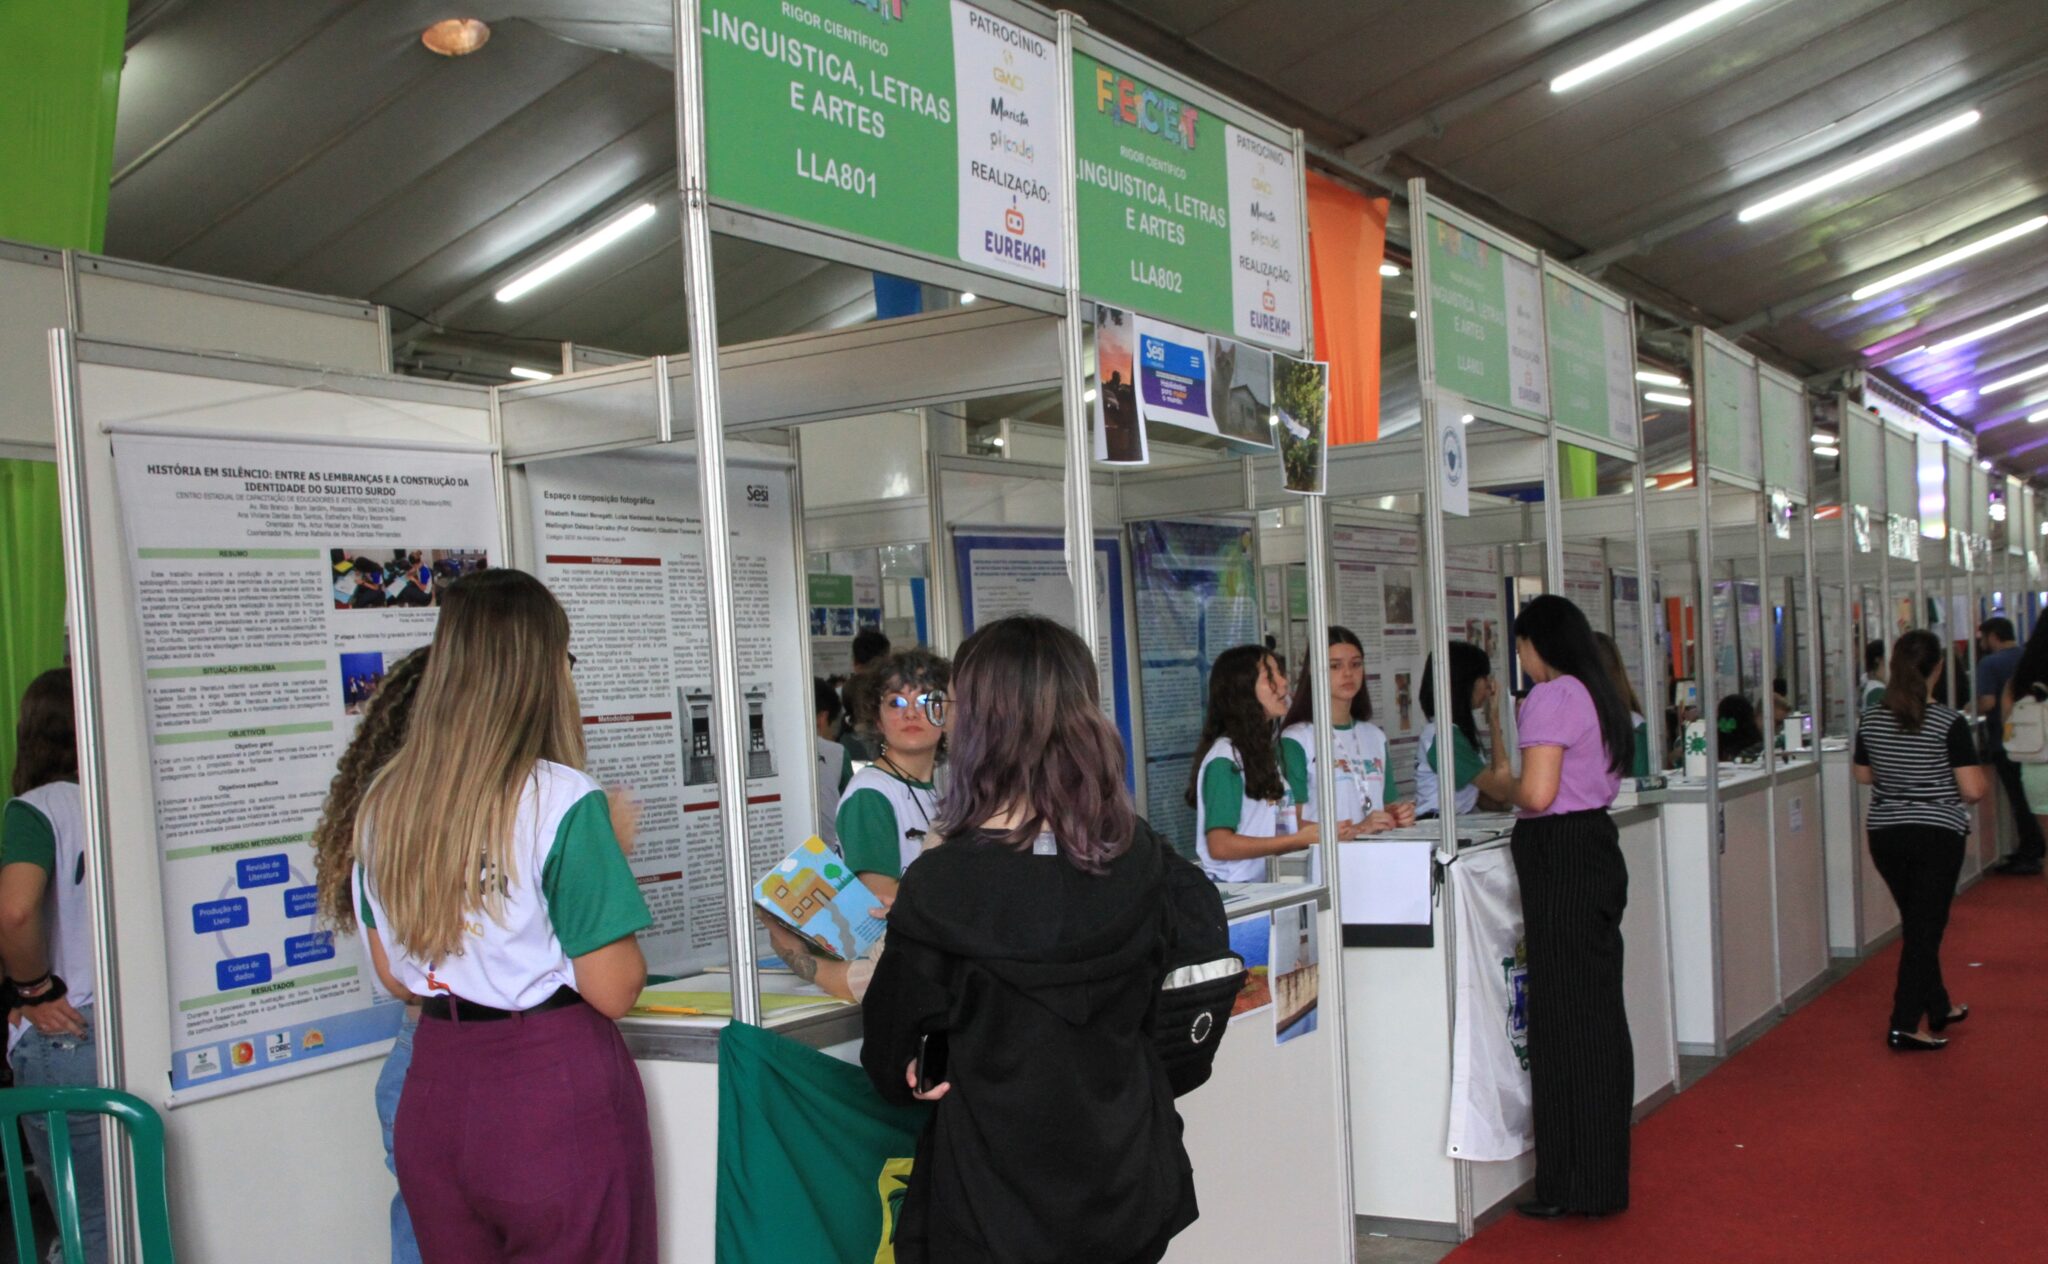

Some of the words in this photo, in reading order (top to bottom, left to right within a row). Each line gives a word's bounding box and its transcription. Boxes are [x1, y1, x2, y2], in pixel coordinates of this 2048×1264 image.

[781, 1, 821, 30] RIGOR
[824, 18, 888, 57] CIENTÍFICO
[970, 11, 1046, 60] PATROCÍNIO:
[870, 70, 950, 124] LETRAS
[790, 81, 805, 112] E
[812, 90, 885, 138] ARTES
[990, 96, 1029, 126] Marista
[797, 148, 876, 198] LLA801
[1120, 145, 1145, 163] RIGOR
[1146, 154, 1187, 180] CIENTÍFICO
[971, 160, 1050, 204] REALIZAÇÃO:
[1076, 158, 1172, 213] INGUISTICA,
[1175, 192, 1226, 228] LETRAS
[1126, 208, 1135, 230] E
[1139, 213, 1185, 246] ARTES
[985, 230, 1046, 269] EUREKA!
[1131, 259, 1183, 293] LLA802
[1239, 255, 1292, 284] REALIZAÇÃO:
[1250, 310, 1290, 336] EUREKA!
[1146, 339, 1164, 362] Sesi
[147, 463, 201, 476] HISTÓRIA
[204, 466, 218, 477] EM
[222, 466, 272, 479] SILÊNCIO:
[275, 470, 306, 481] ENTRE
[309, 472, 321, 481] AS
[323, 473, 383, 485] LEMBRANÇAS
[386, 475, 390, 484] E
[393, 475, 399, 484] A
[401, 475, 456, 487] CONSTRUÇÃO
[458, 478, 469, 487] DA
[244, 482, 306, 493] IDENTIDADE
[308, 486, 322, 494] DO
[325, 486, 363, 495] SUJEITO
[365, 487, 396, 496] SURDO
[544, 490, 571, 500] Espaço
[578, 495, 619, 504] composição
[620, 496, 655, 506] fotográfica
[747, 485, 769, 502] Sesi
[203, 665, 238, 674] SITUAÇÃO
[240, 664, 276, 672] PROBLEMA
[228, 728, 266, 738] OBJETIVOS
[235, 742, 258, 750] Objetivo
[260, 740, 273, 749] geral
[211, 841, 250, 853] PERCURSO
[251, 834, 303, 848] METODOLÓGICO
[246, 862, 270, 872] Revisão
[248, 871, 279, 881] Literatura
[199, 905, 231, 917] Produção
[228, 962, 249, 973] Coleta
[234, 972, 255, 982] dados
[251, 980, 295, 995] RESULTADOS
